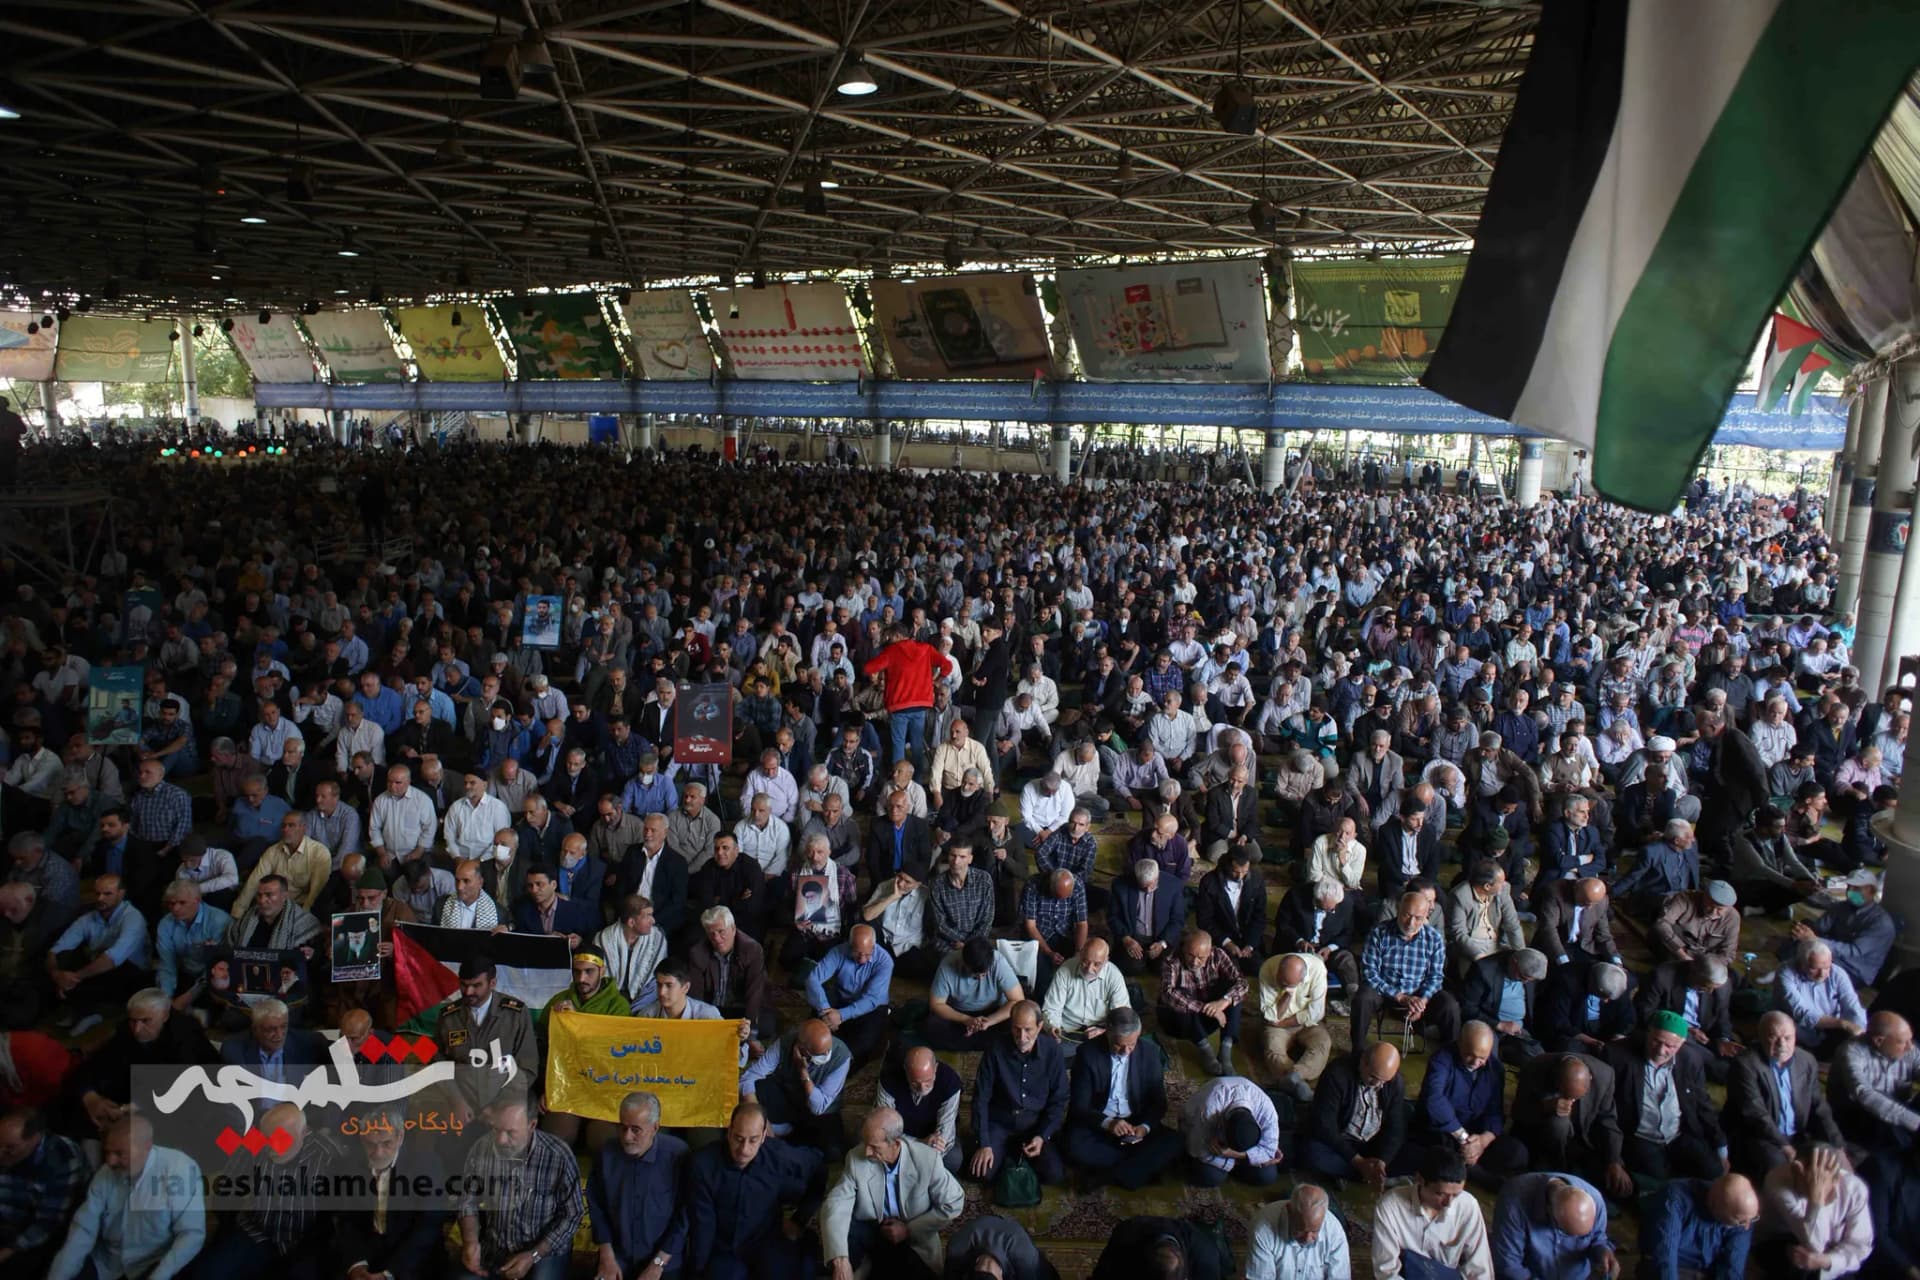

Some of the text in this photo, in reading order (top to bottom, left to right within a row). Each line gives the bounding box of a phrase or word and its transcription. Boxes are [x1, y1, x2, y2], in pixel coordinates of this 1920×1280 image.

[1310, 308, 1351, 337] بخوان
[610, 1035, 662, 1057] قدس
[642, 1074, 672, 1085] محمد
[673, 1073, 696, 1088] سپاه
